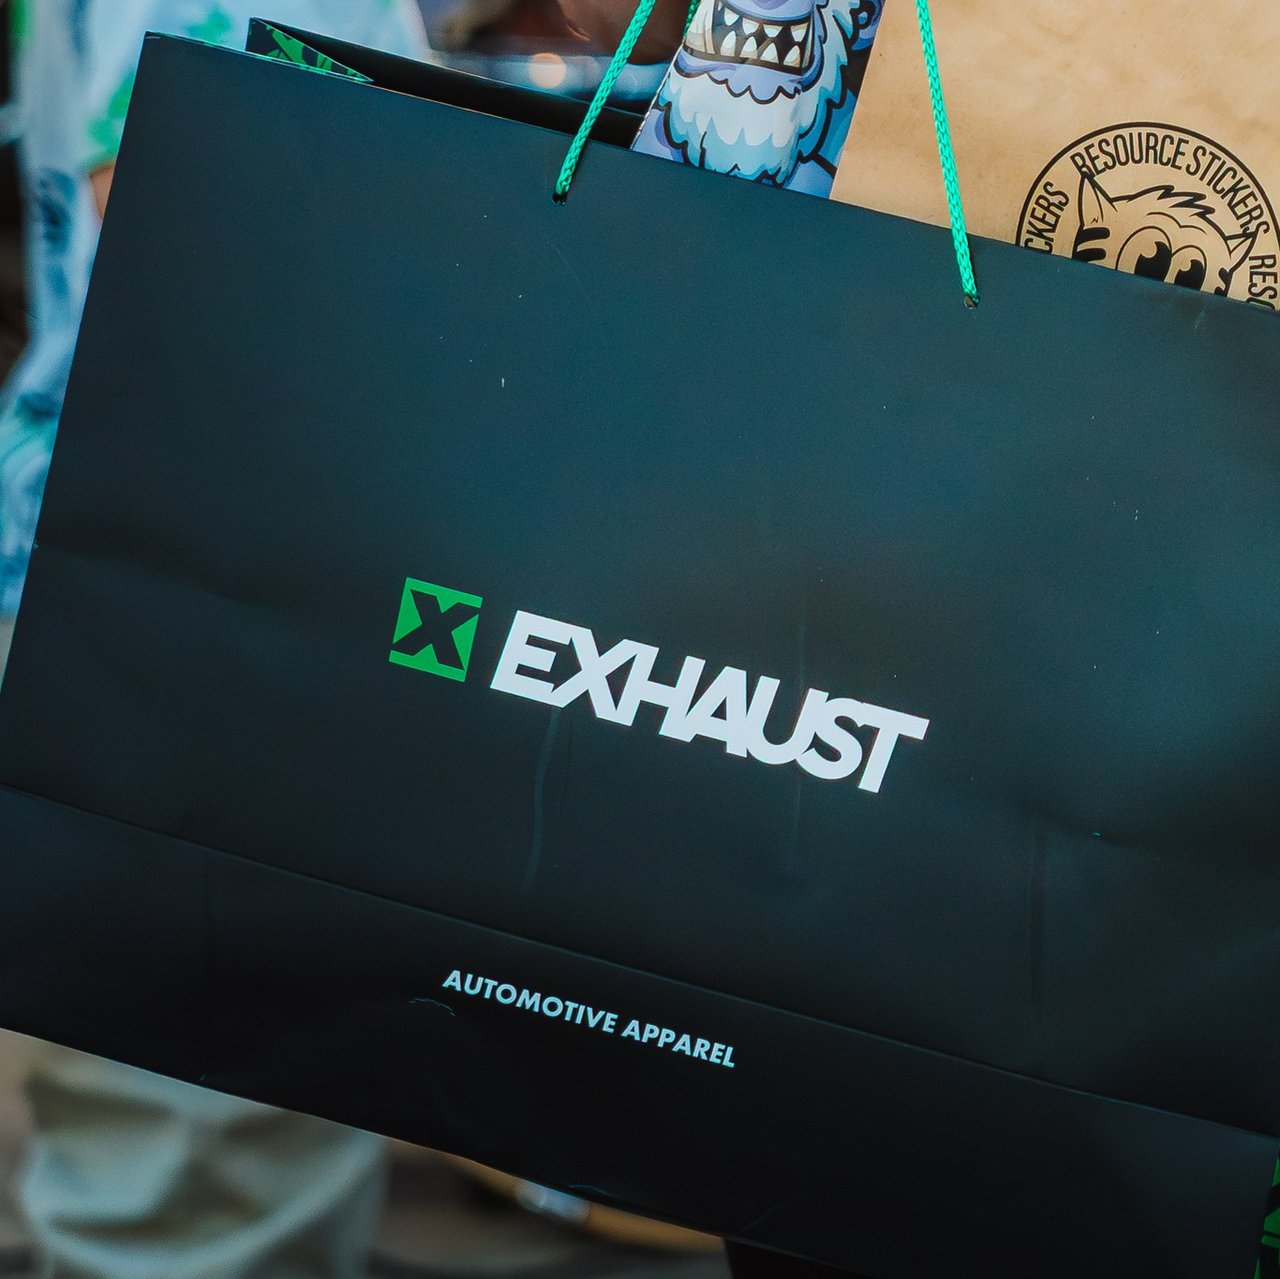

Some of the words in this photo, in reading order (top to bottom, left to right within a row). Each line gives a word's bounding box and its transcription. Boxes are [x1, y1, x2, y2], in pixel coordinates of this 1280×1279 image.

[1024, 180, 1070, 254] CKERS
[1069, 131, 1190, 179] RESOURCE
[1185, 144, 1271, 236] STICKERS
[490, 609, 930, 793] EXHAUST
[442, 969, 619, 1034] AUTOMOTIVE
[620, 1019, 736, 1069] APPAREL
